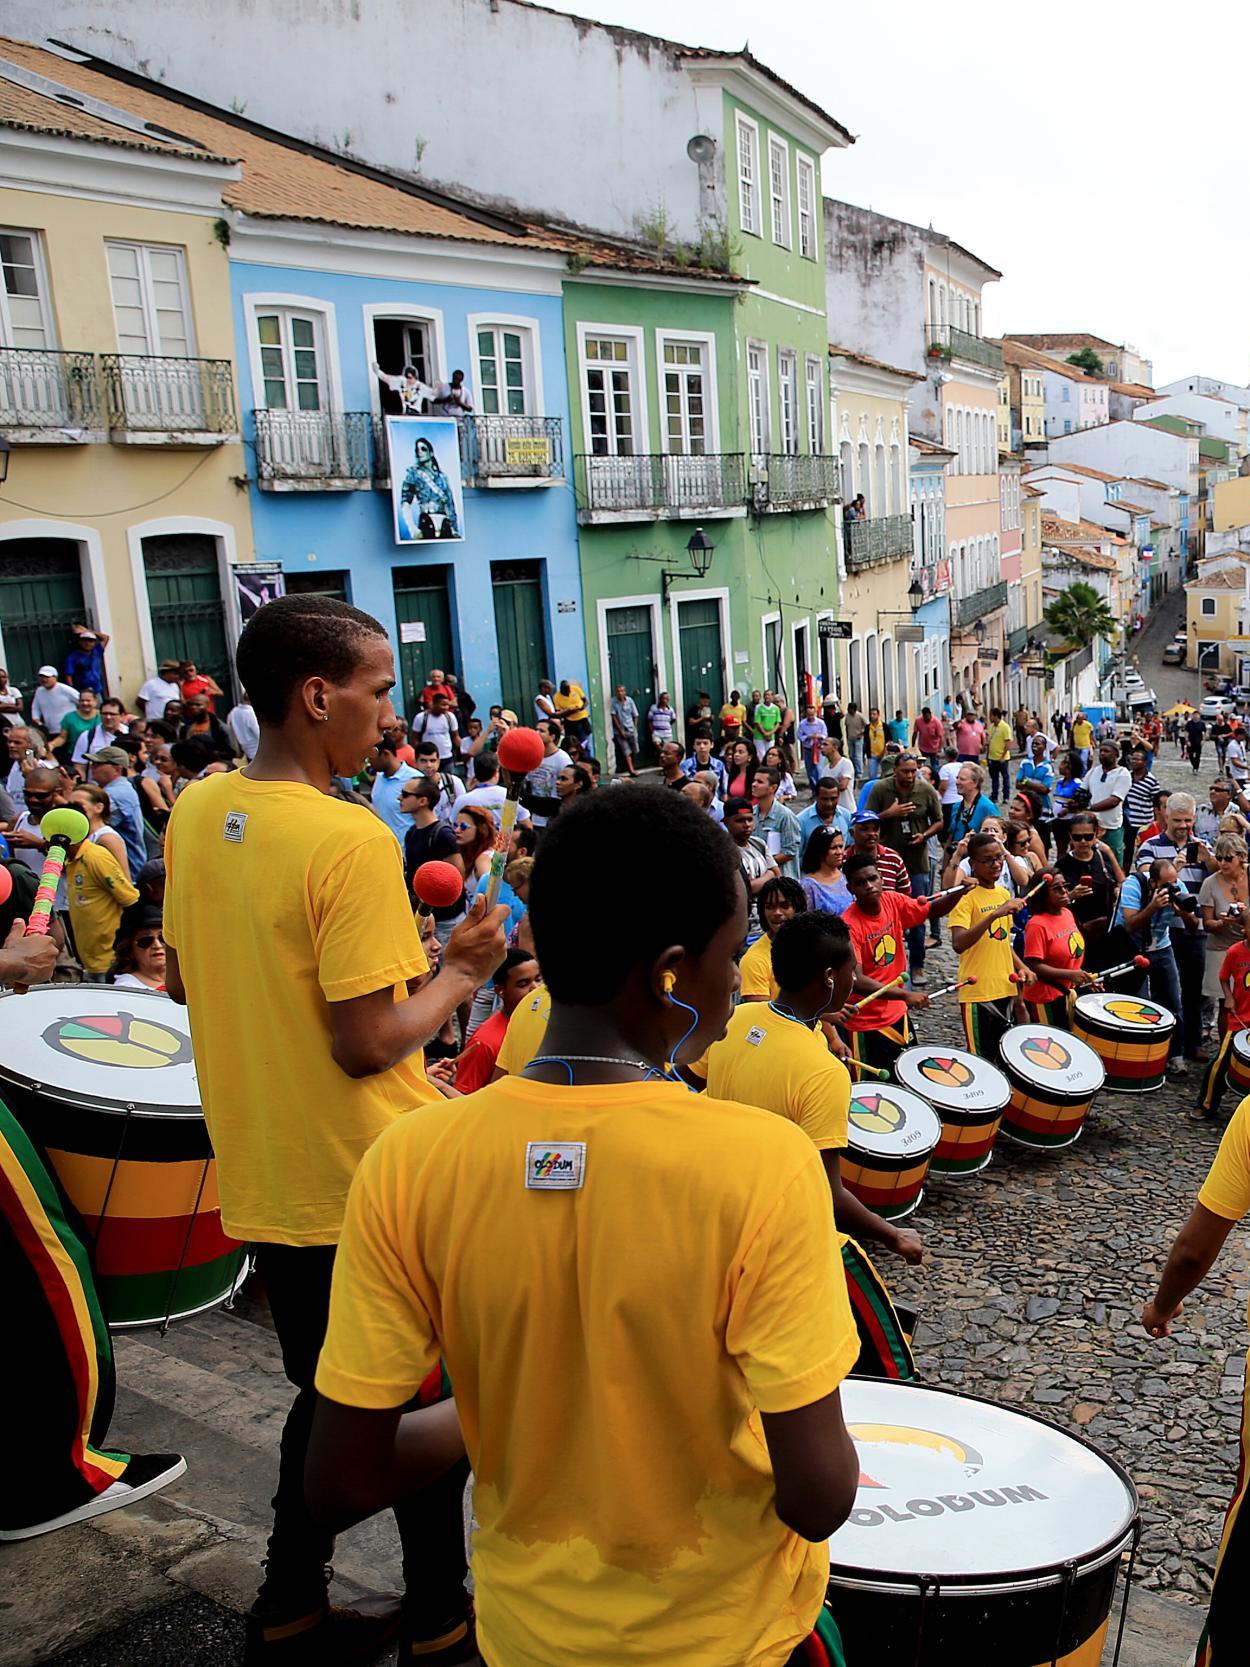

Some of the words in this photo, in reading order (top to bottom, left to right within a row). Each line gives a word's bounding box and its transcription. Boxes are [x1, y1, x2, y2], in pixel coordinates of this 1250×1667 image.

[1066, 1071, 1083, 1083] GOPE
[963, 1089, 985, 1100] GOPE
[901, 1130, 922, 1148] GOPE
[534, 1159, 573, 1171] OLODUM
[848, 1484, 1050, 1527] OLODUM
